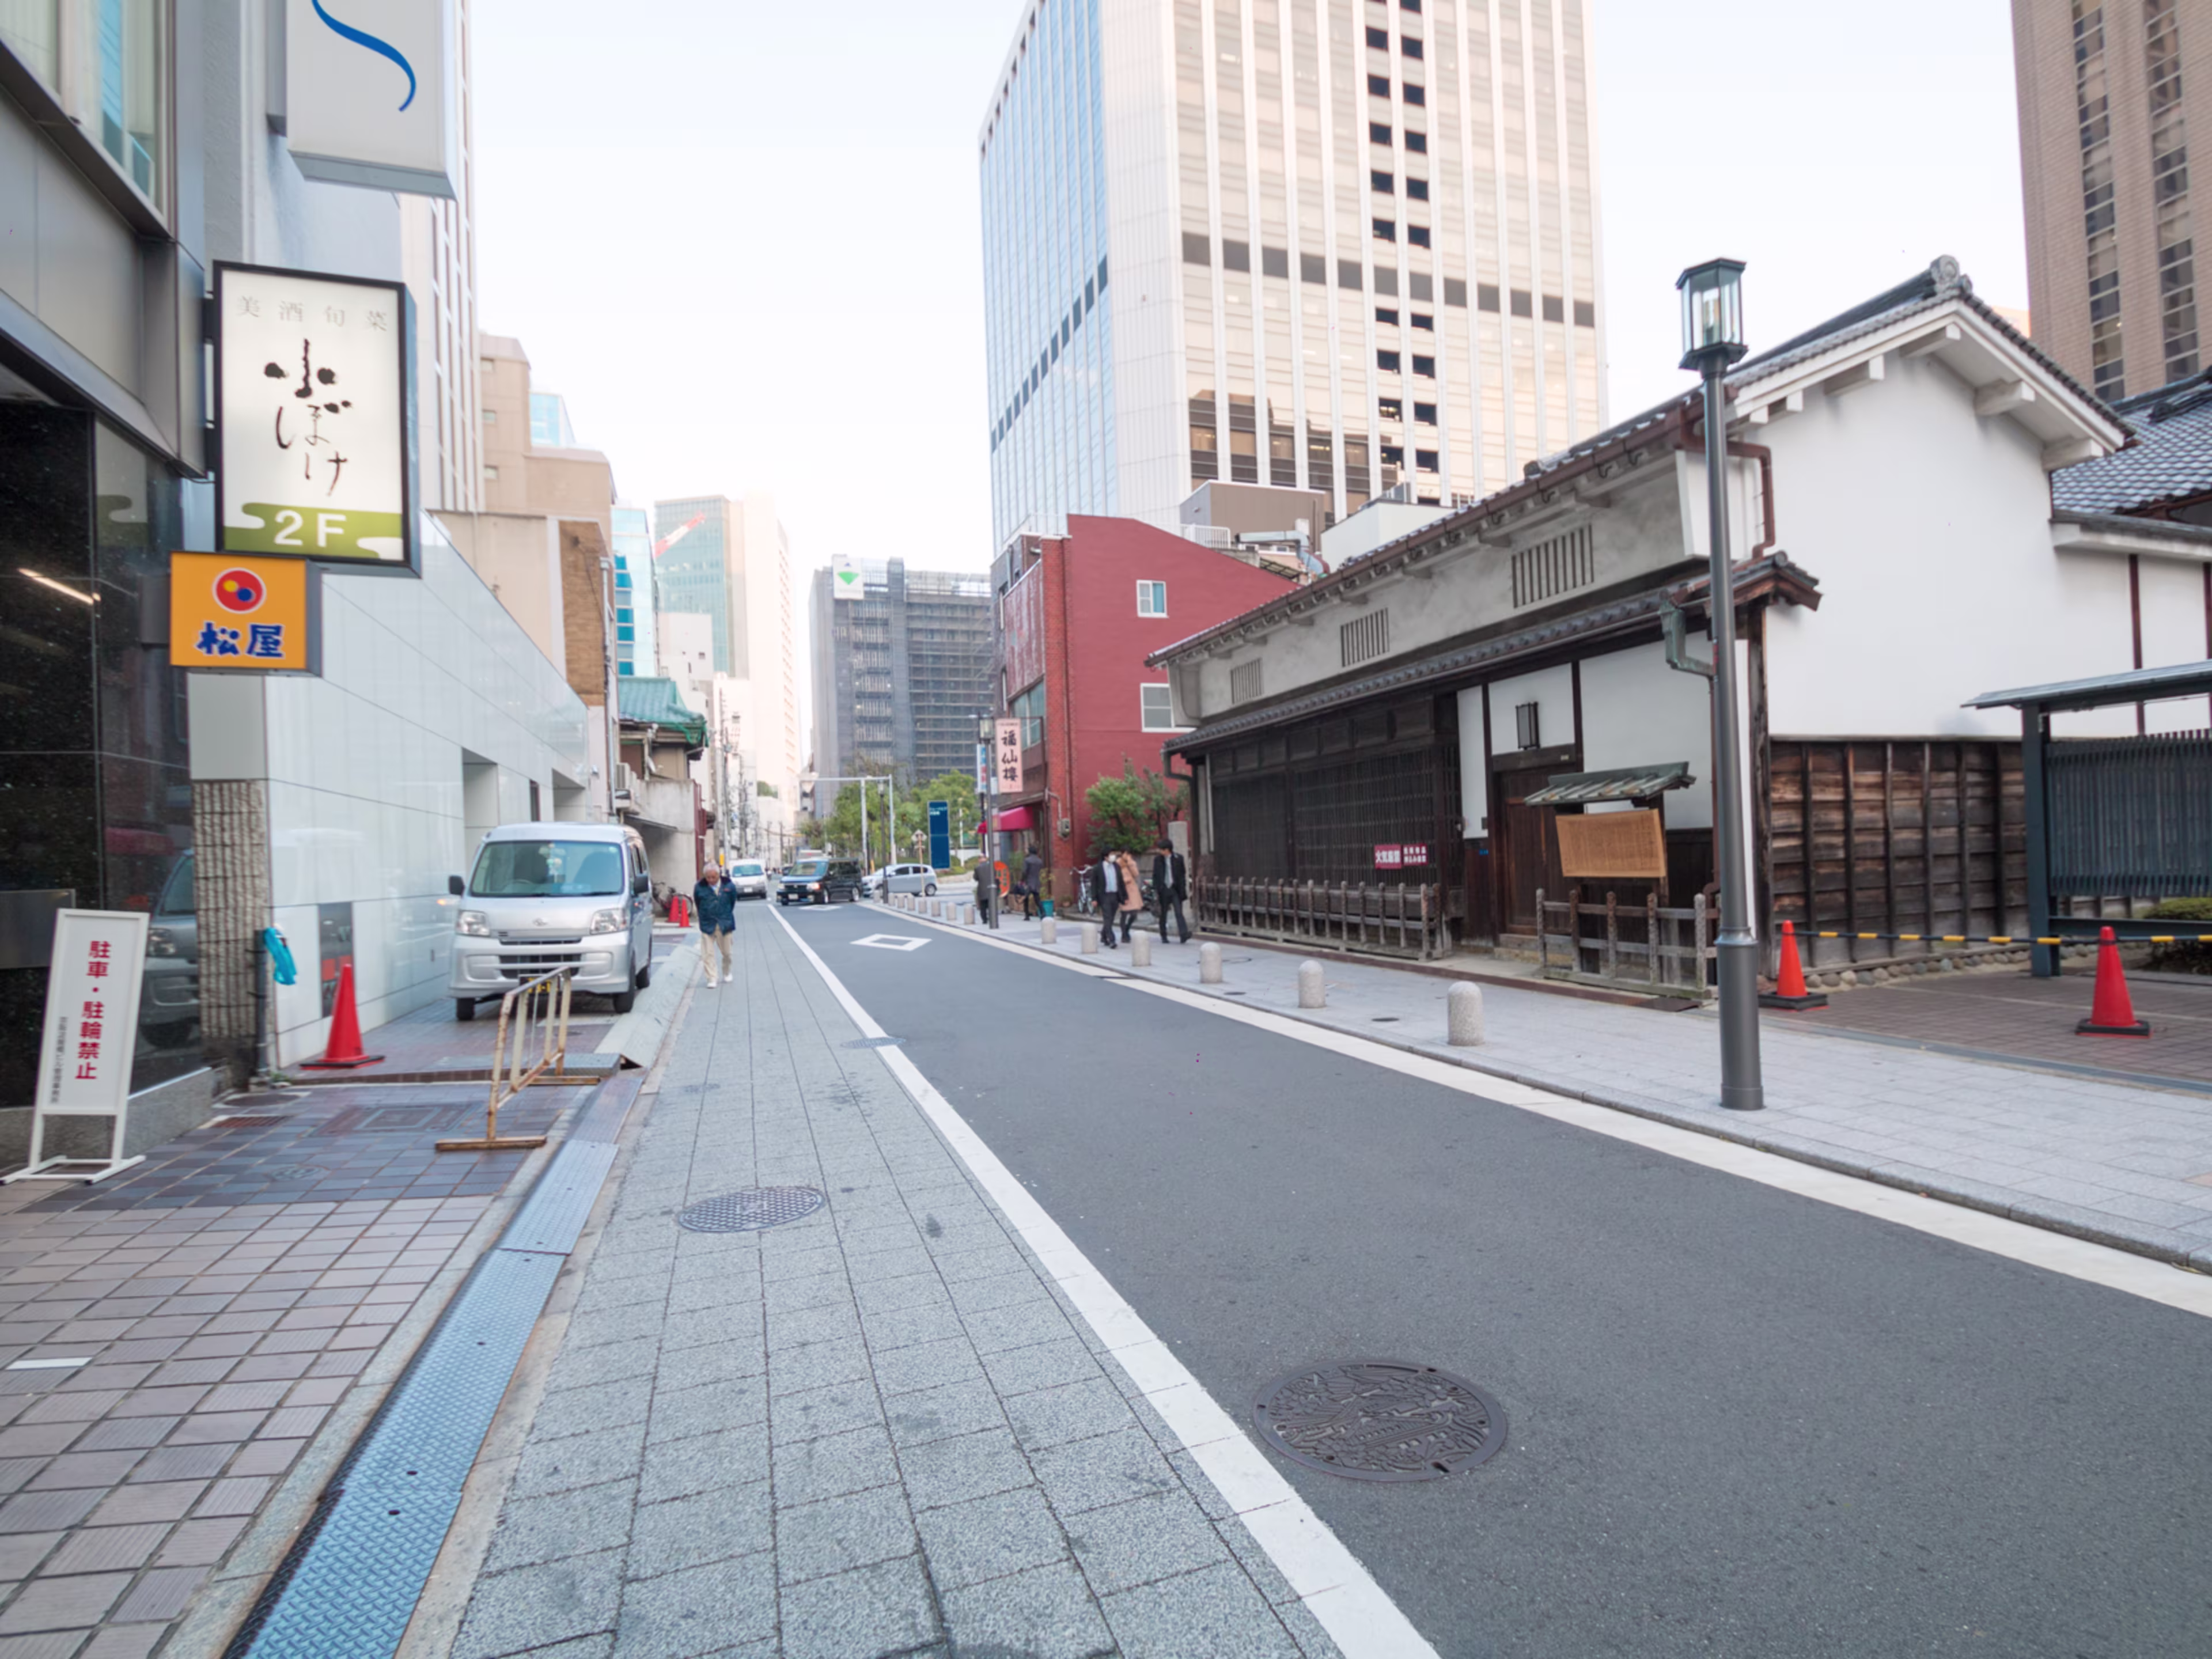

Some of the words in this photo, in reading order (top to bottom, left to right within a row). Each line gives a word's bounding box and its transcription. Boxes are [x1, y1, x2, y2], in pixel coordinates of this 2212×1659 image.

[237, 295, 388, 332] 美酒旬菜
[274, 509, 347, 547] 2F
[196, 622, 286, 659] 松屋
[75, 941, 112, 1080] 駐車・駐輪禁止
